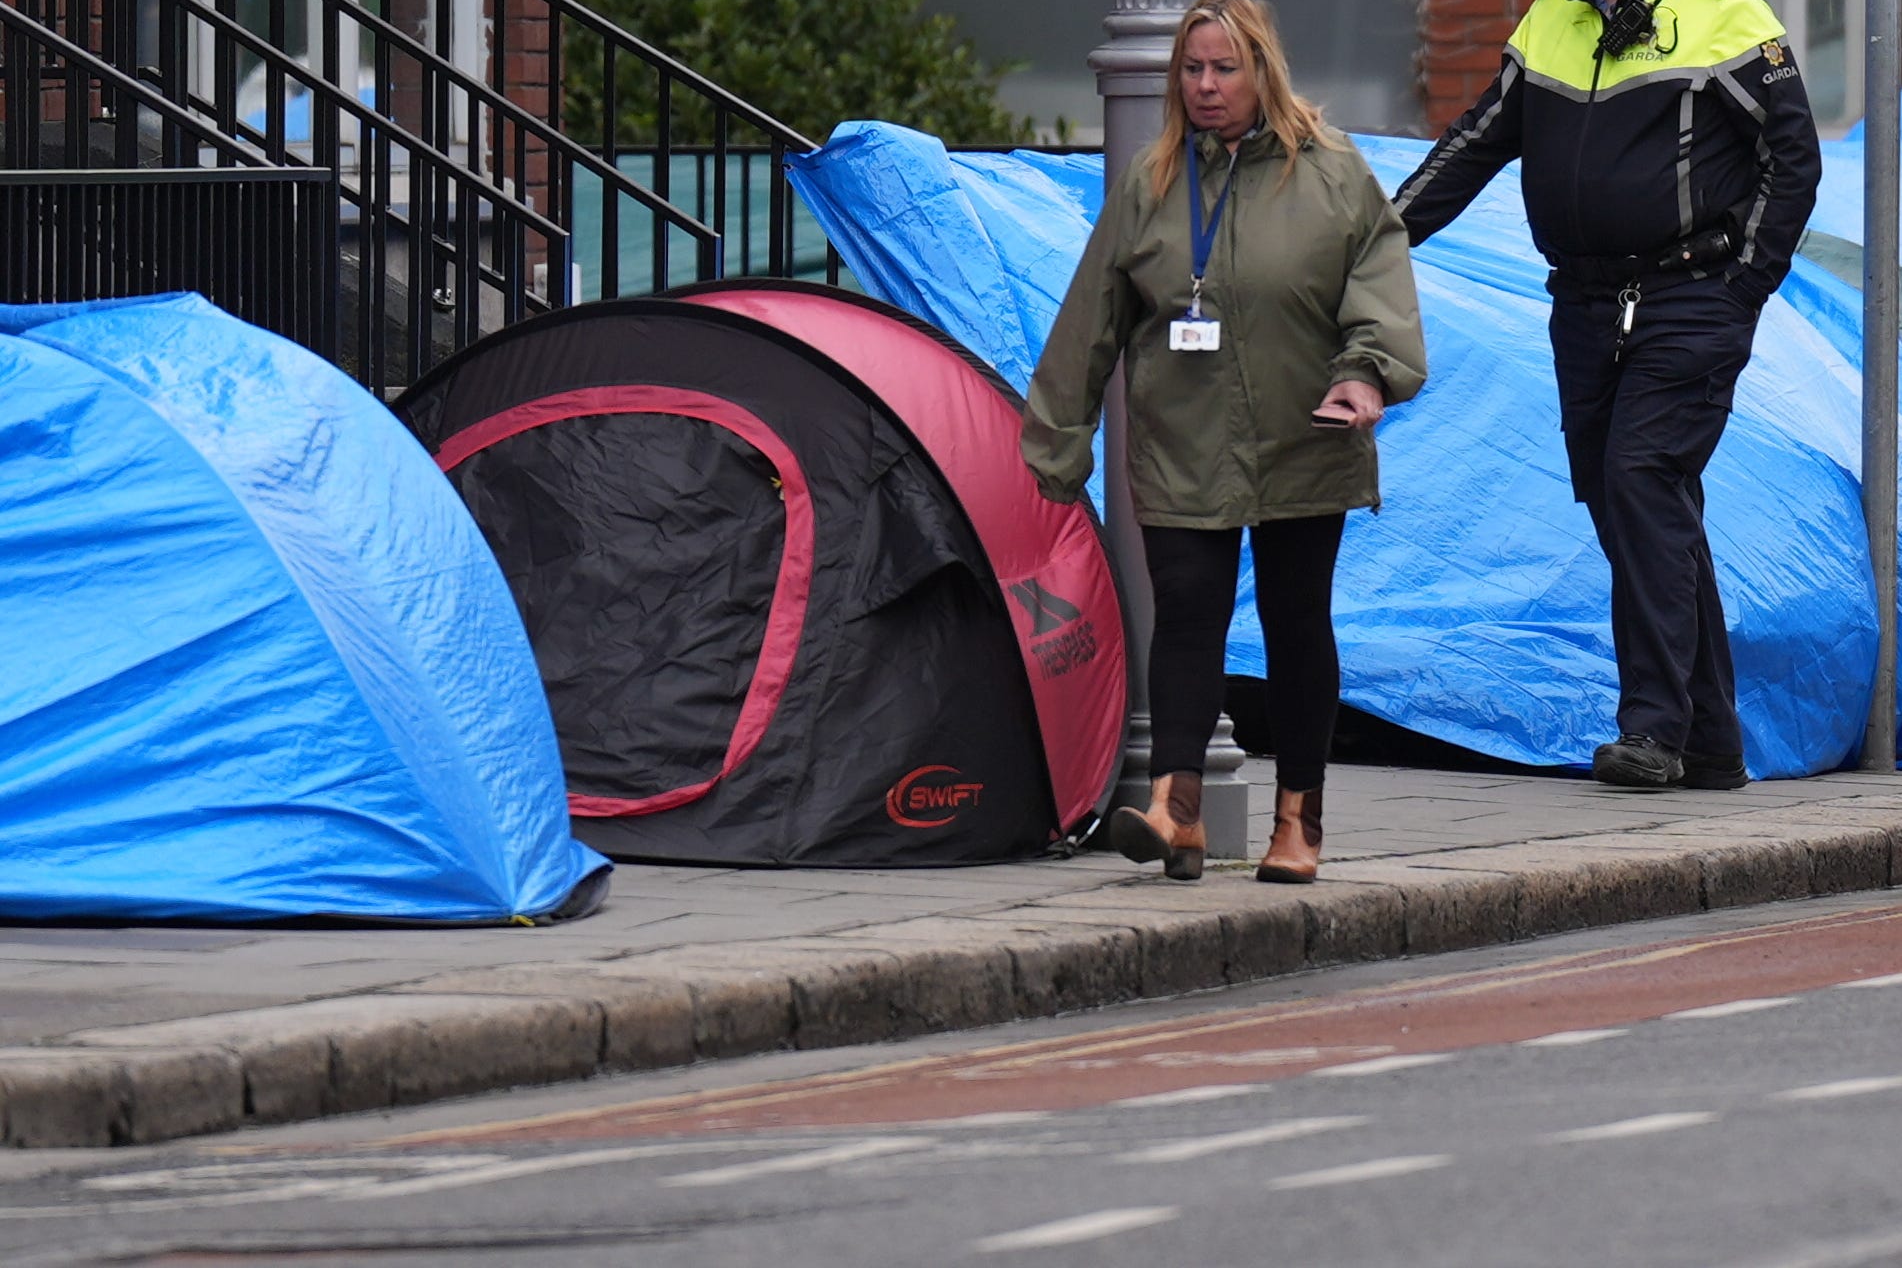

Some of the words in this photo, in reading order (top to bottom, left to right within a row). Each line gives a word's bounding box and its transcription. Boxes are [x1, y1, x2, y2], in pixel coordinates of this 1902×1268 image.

[1617, 51, 1665, 63] GARDA
[1763, 66, 1799, 85] GARDA
[908, 784, 983, 809] SWIFT
